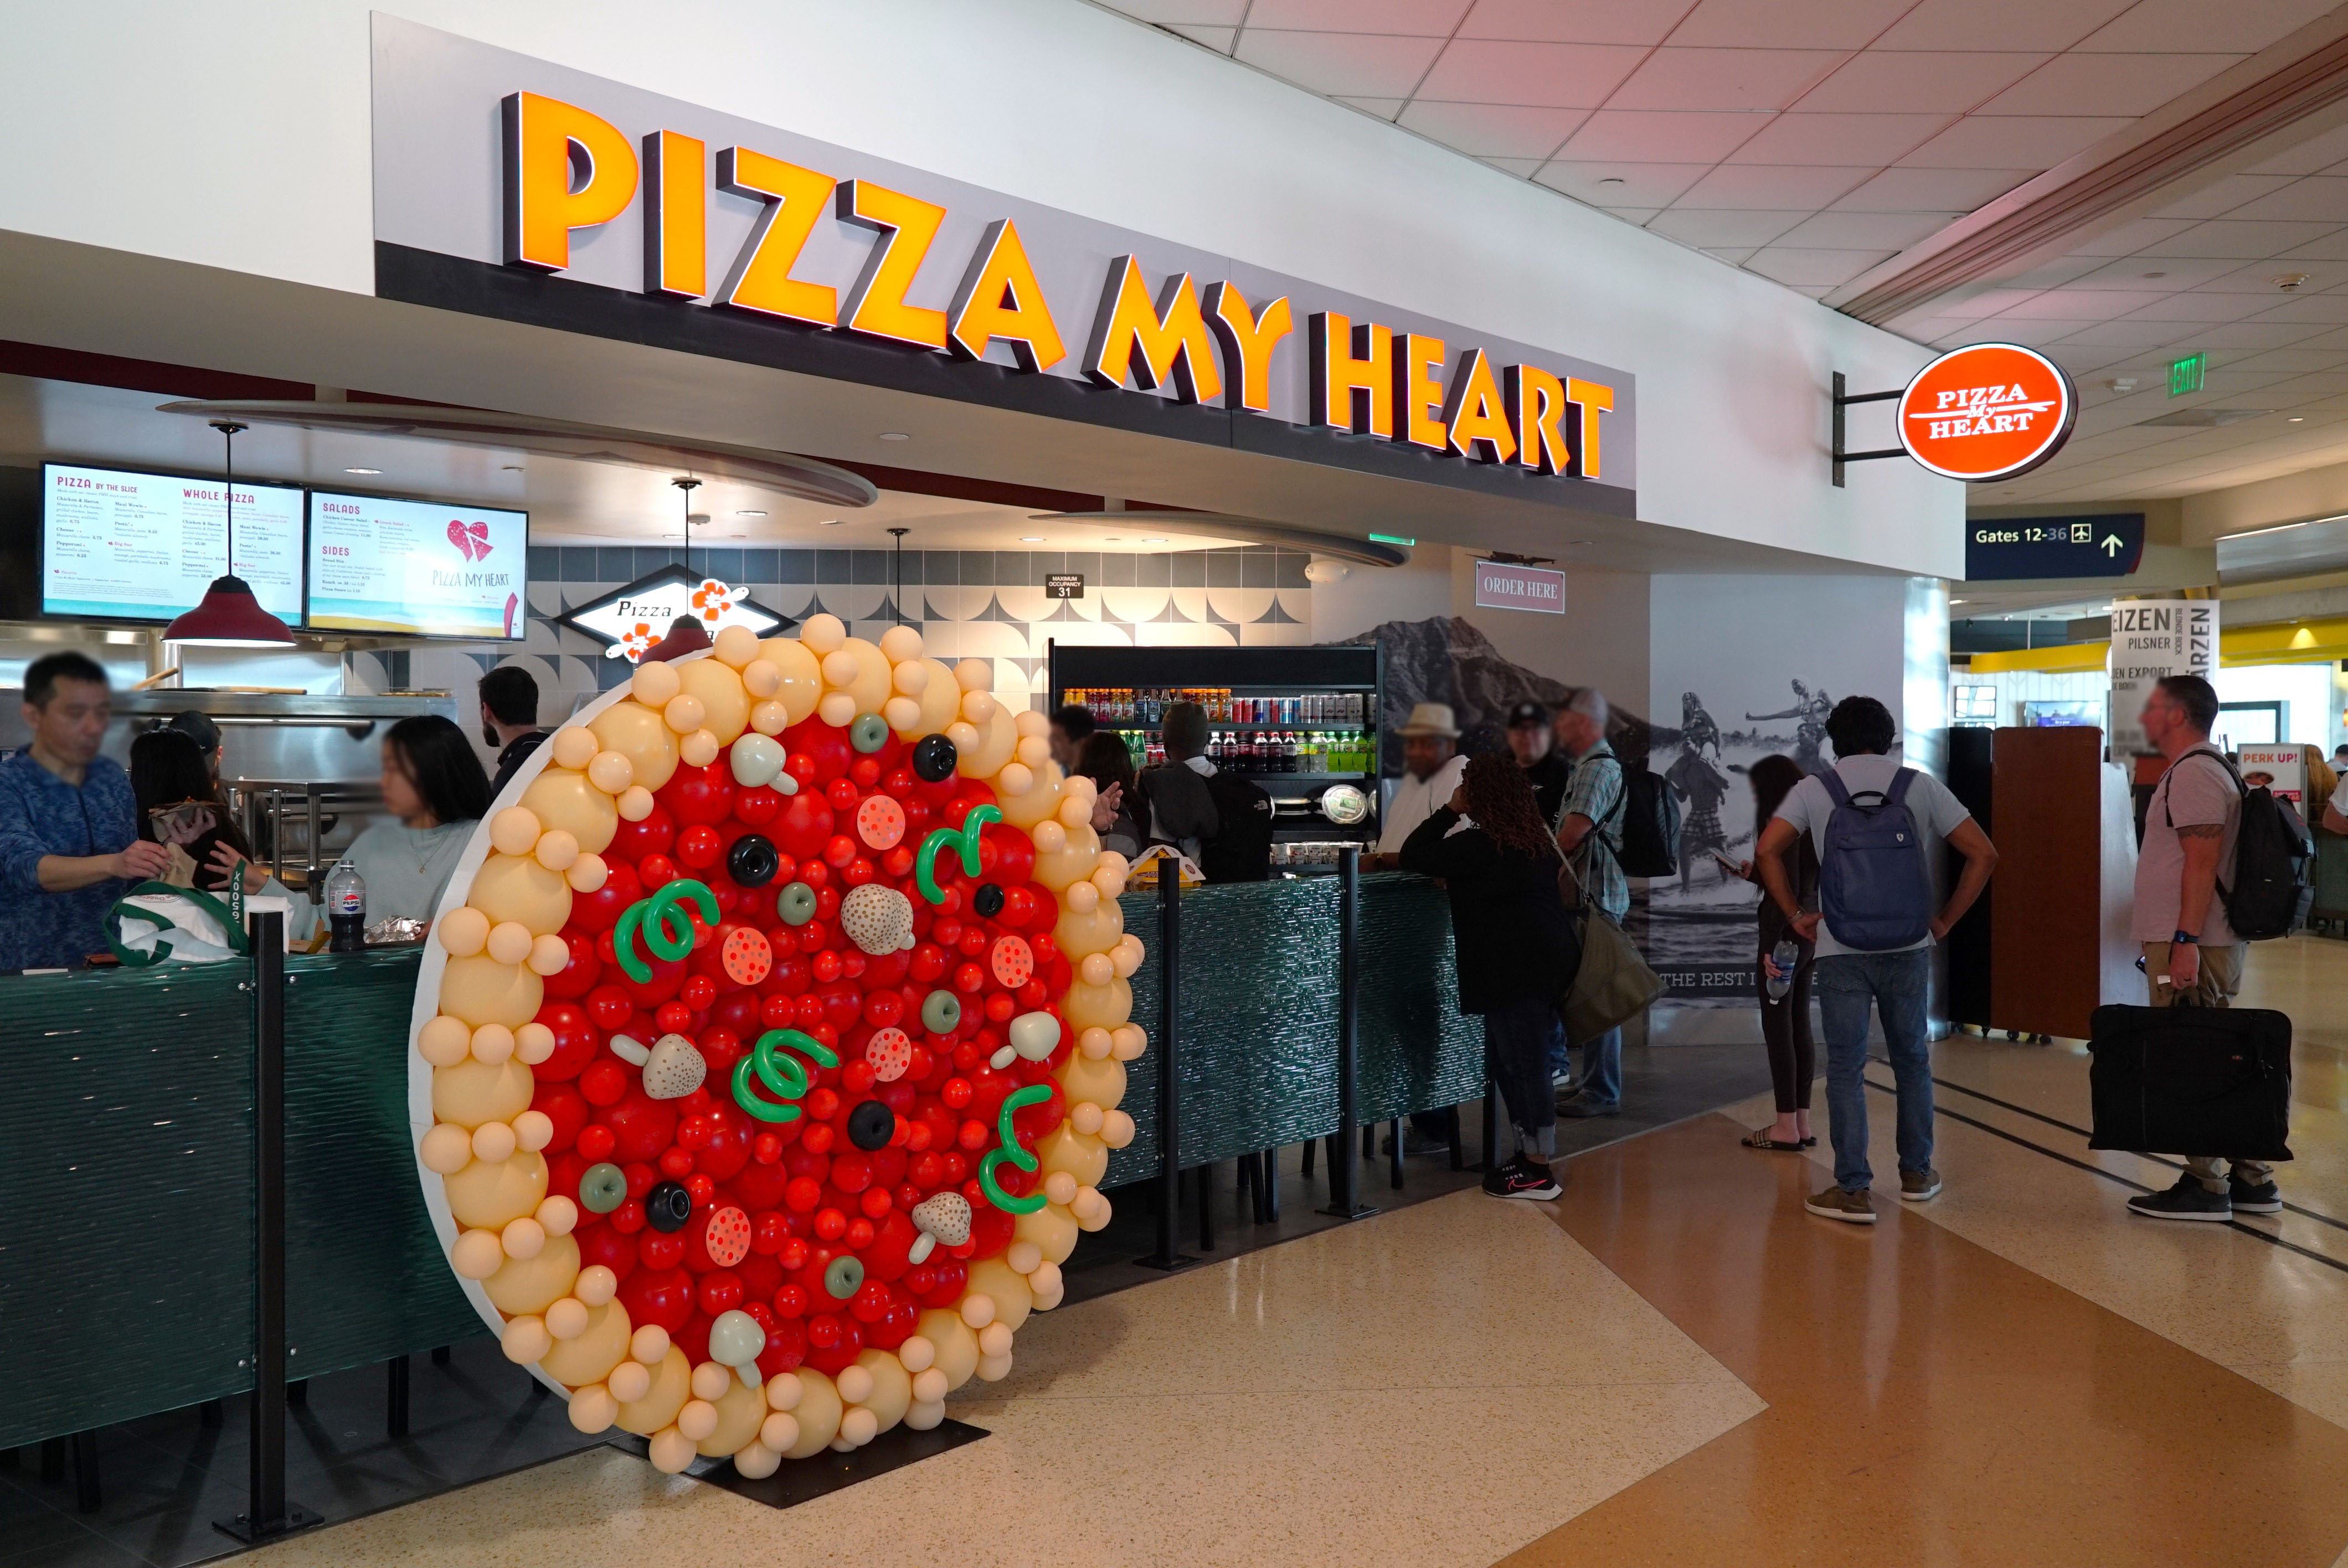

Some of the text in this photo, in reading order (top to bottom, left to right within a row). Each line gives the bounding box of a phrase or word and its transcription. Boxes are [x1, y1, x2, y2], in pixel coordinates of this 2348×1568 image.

[509, 89, 1614, 481] PIZZA MY HEART
[2174, 358, 2197, 394] EXIT
[1937, 383, 2028, 409] PIZZA
[1967, 404, 1996, 419] My
[1929, 412, 2033, 439] HEART
[57, 476, 91, 489] PIZZA
[121, 485, 138, 493] SLICE
[183, 488, 255, 504] WHOLE PIZZA
[323, 503, 360, 514] SALADS
[1976, 527, 2067, 544] Gates 12-36
[322, 546, 349, 556] SIDES
[432, 570, 509, 587] PIZZA MY HEART
[1058, 587, 1070, 597] 31
[1484, 576, 1557, 599] ORDER HERE
[617, 601, 671, 616] Pizza
[2112, 608, 2170, 632] EIZEN
[2129, 637, 2170, 649] PILSNER
[2186, 608, 2210, 682] ÄRZEN
[2129, 667, 2173, 679] EXPORT
[2244, 753, 2298, 763] PERK UP!
[1659, 973, 1695, 987] THE
[1701, 972, 1745, 986] REST
